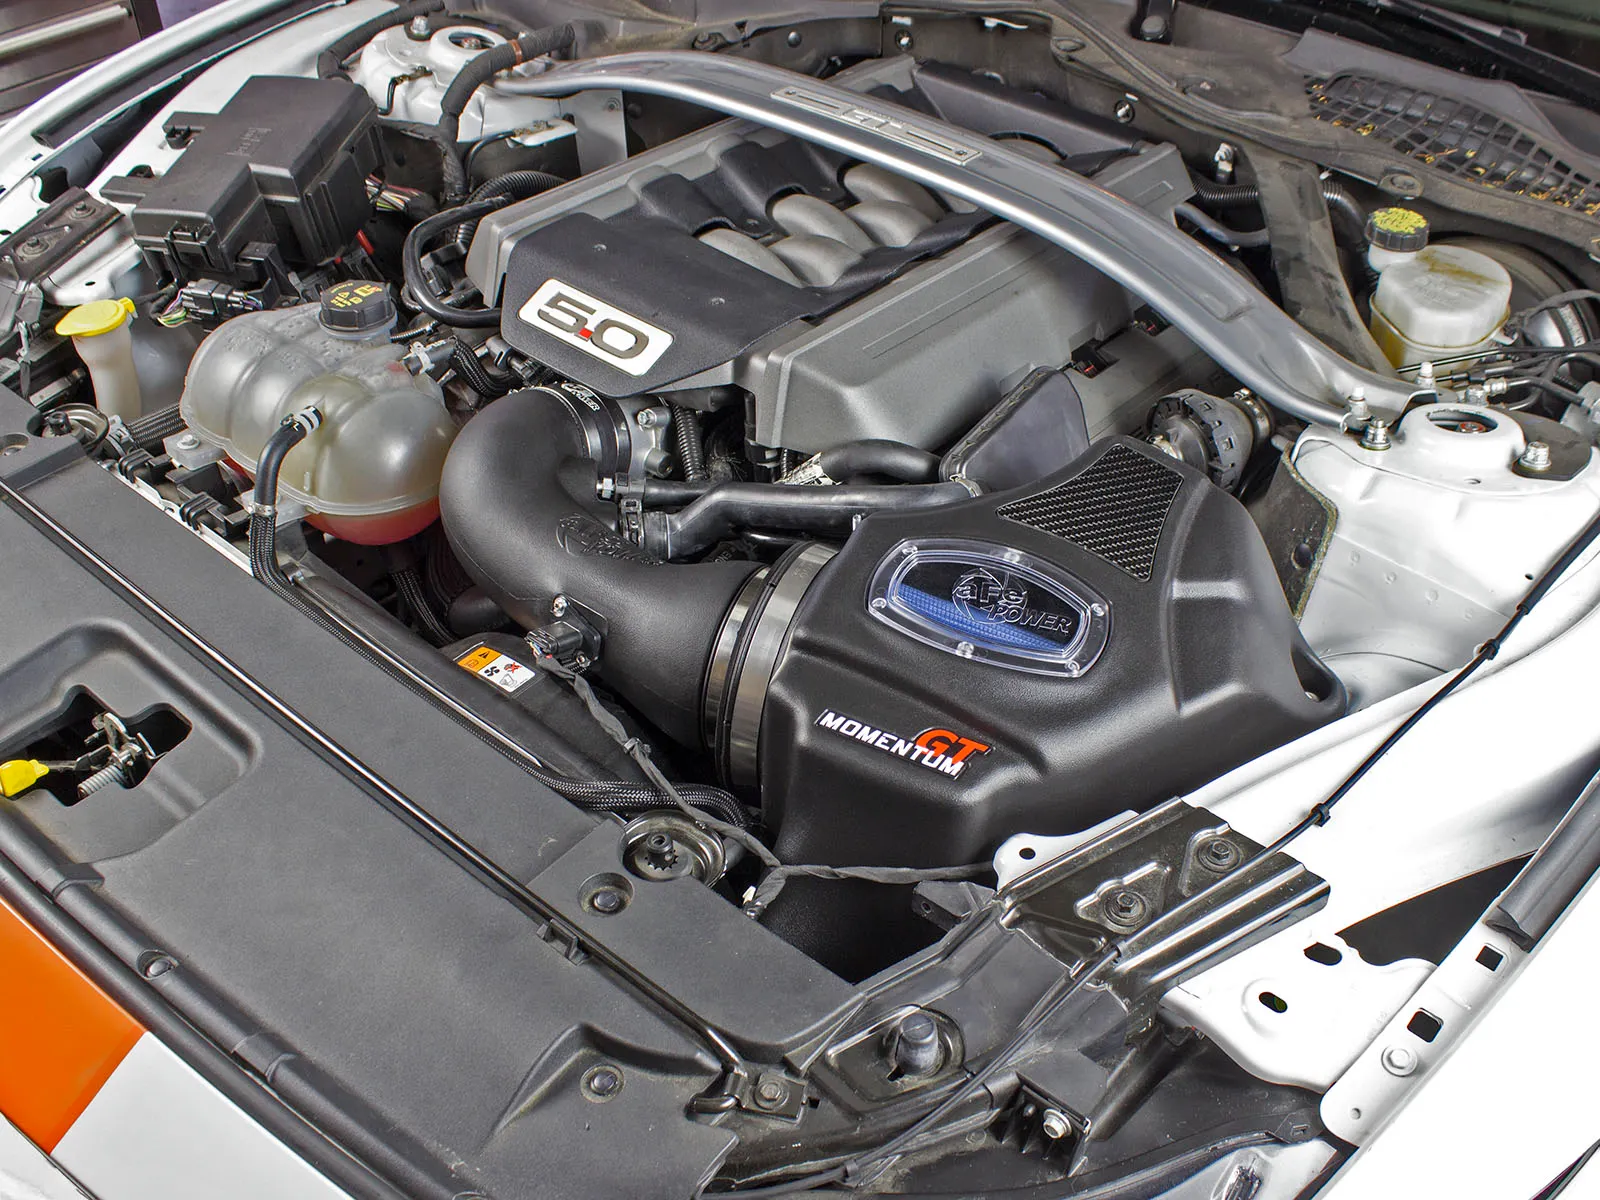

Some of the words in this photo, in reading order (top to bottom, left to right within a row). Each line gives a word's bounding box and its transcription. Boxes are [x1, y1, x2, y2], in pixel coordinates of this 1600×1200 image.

[537, 291, 650, 359] 5.0
[956, 579, 1028, 605] aFe
[988, 602, 1072, 634] POWER
[819, 711, 965, 777] MOMENTUM
[915, 728, 989, 765] GT
